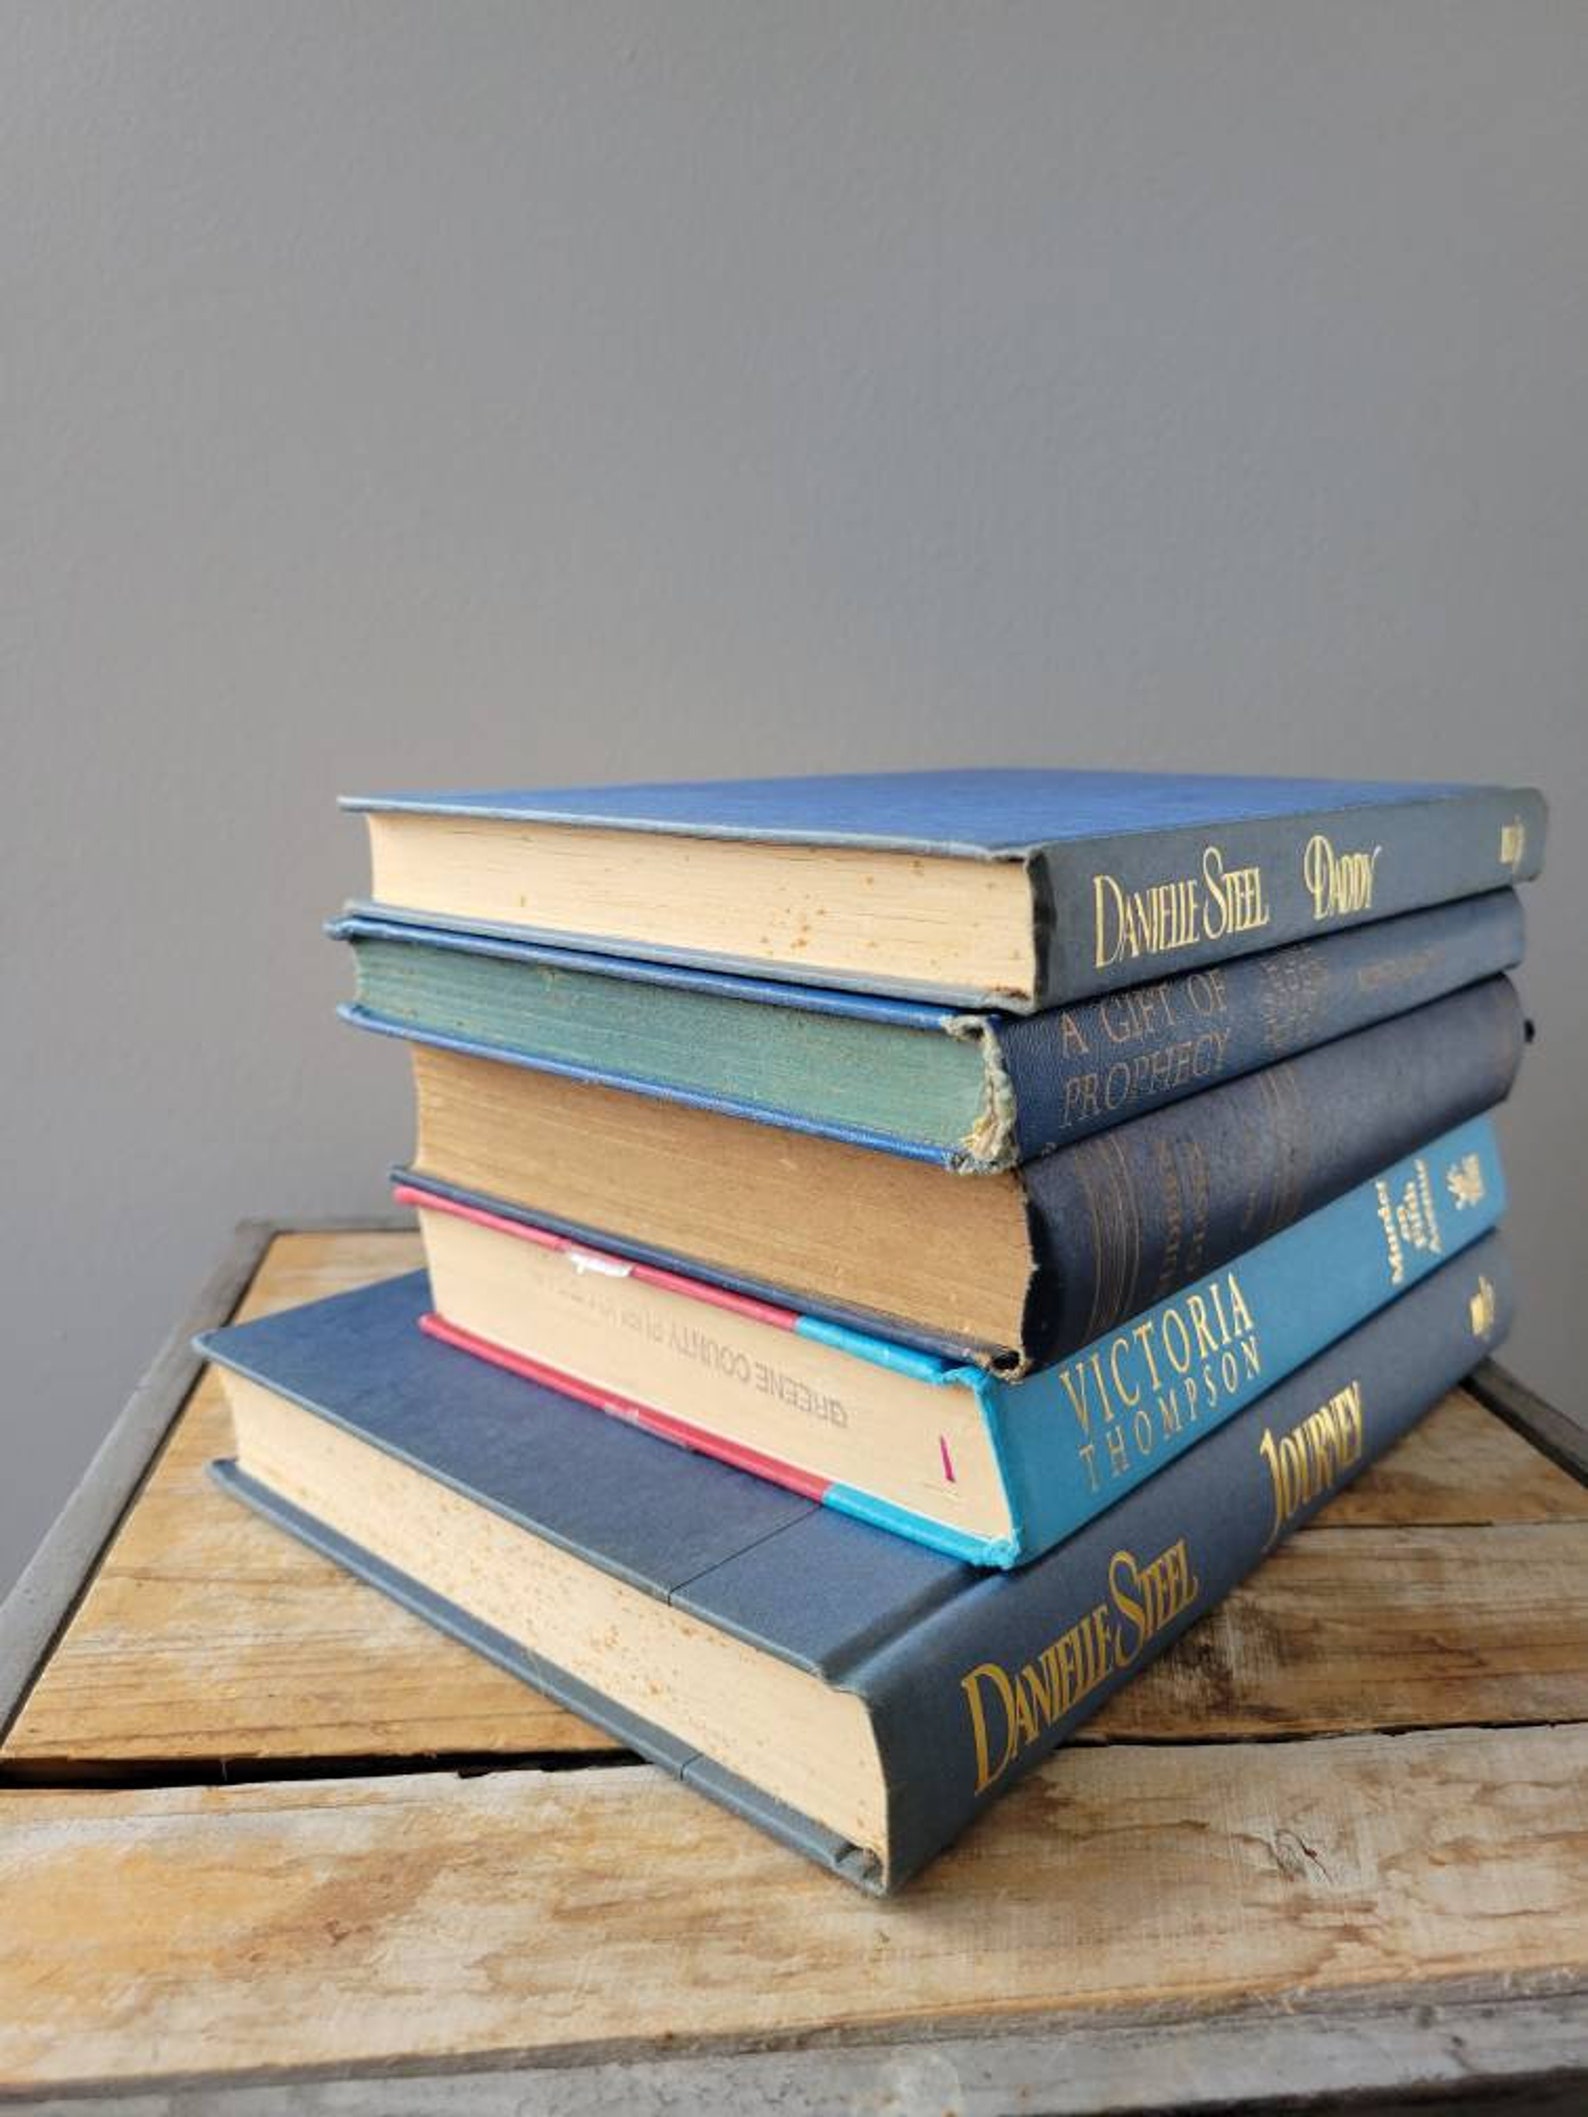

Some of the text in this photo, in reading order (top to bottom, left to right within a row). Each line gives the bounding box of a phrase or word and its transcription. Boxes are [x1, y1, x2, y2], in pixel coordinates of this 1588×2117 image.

[1092, 846, 1270, 969] DANIELLE STEEL
[1058, 1027, 1231, 1128] PROPHECY
[1060, 1011, 1089, 1060] A
[1100, 982, 1176, 1043] GIFT
[1187, 969, 1228, 1016] OF
[667, 1323, 849, 1430] GREENE COUNTY
[1060, 1271, 1255, 1432] VICTORIA
[1077, 1334, 1264, 1493] THOMPSON
[1258, 1380, 1363, 1553] JOURNEY
[961, 1537, 1199, 1797] DANIELLE STEEL
